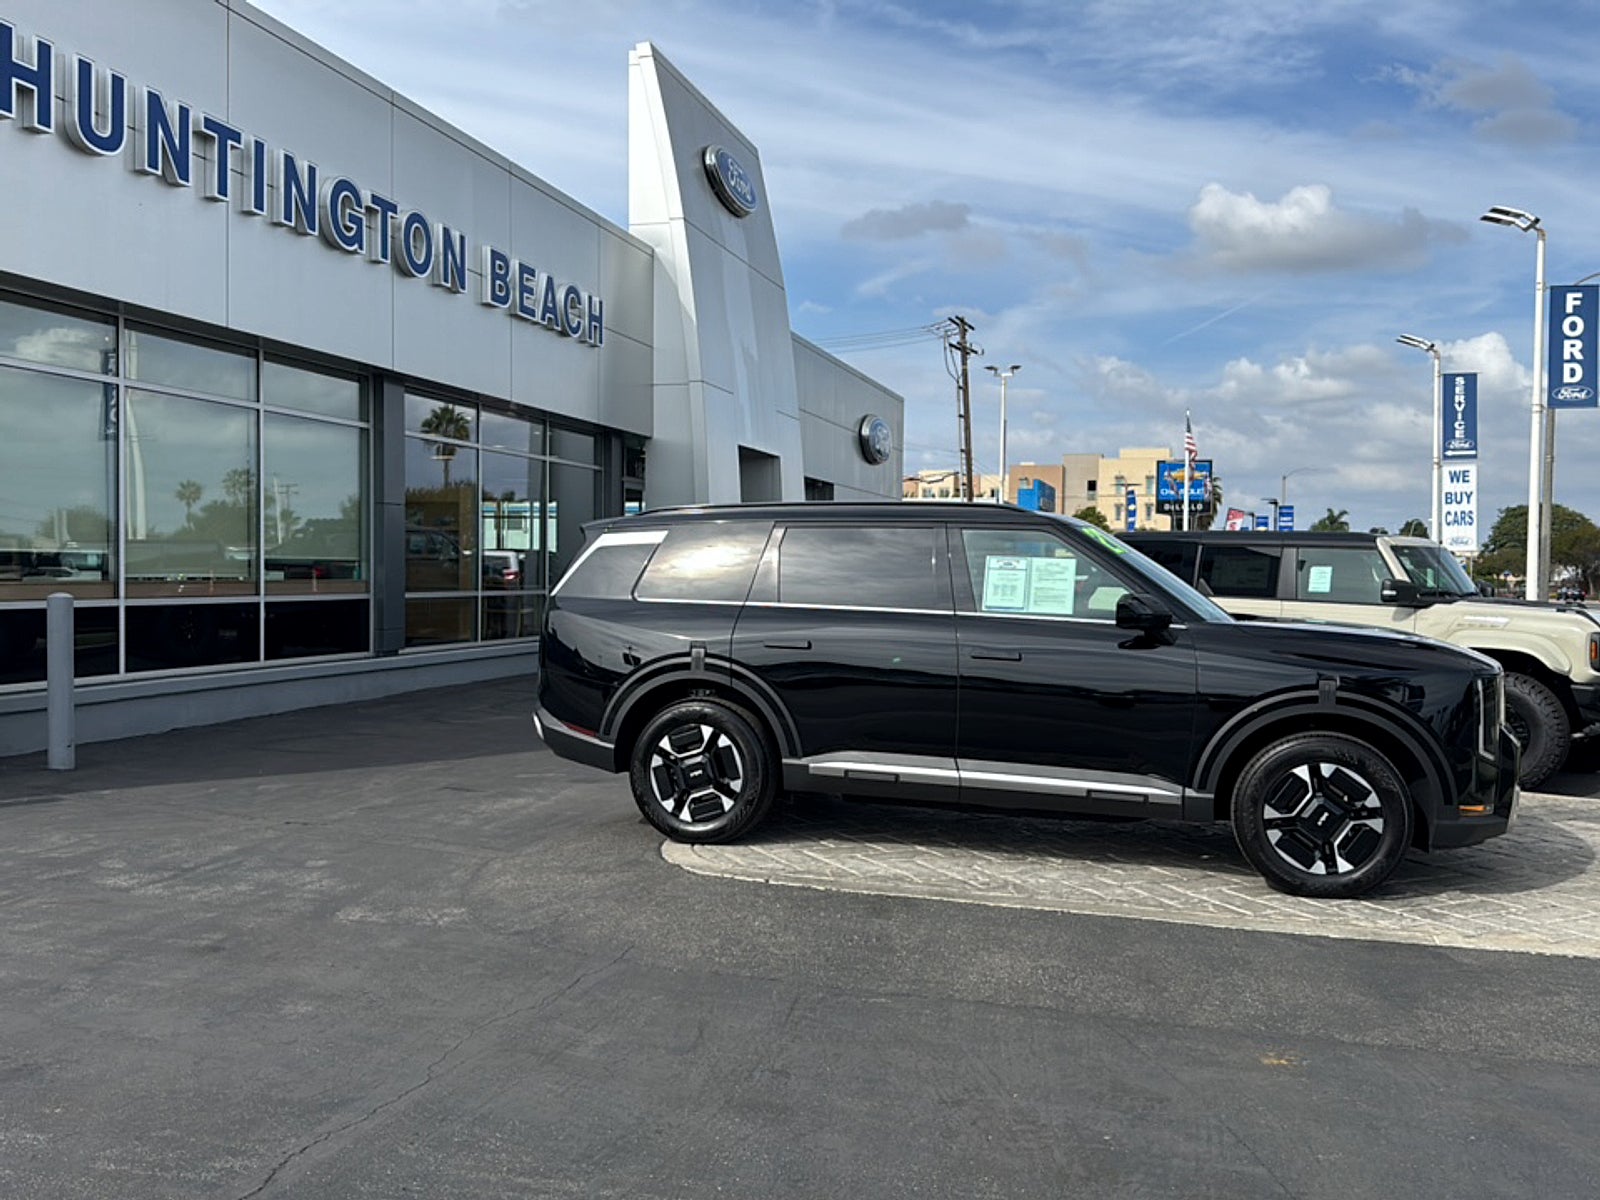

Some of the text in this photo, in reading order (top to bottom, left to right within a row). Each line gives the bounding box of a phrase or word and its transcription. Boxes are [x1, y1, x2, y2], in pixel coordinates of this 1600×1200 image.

[0, 18, 604, 347] HUNTINGTON BEACH
[1561, 291, 1585, 384] FORD
[1556, 387, 1588, 400] Ford
[1454, 376, 1466, 438] SERVICE
[1448, 469, 1470, 483] WE
[1445, 491, 1473, 505] BUY
[1445, 510, 1474, 527] CARS
